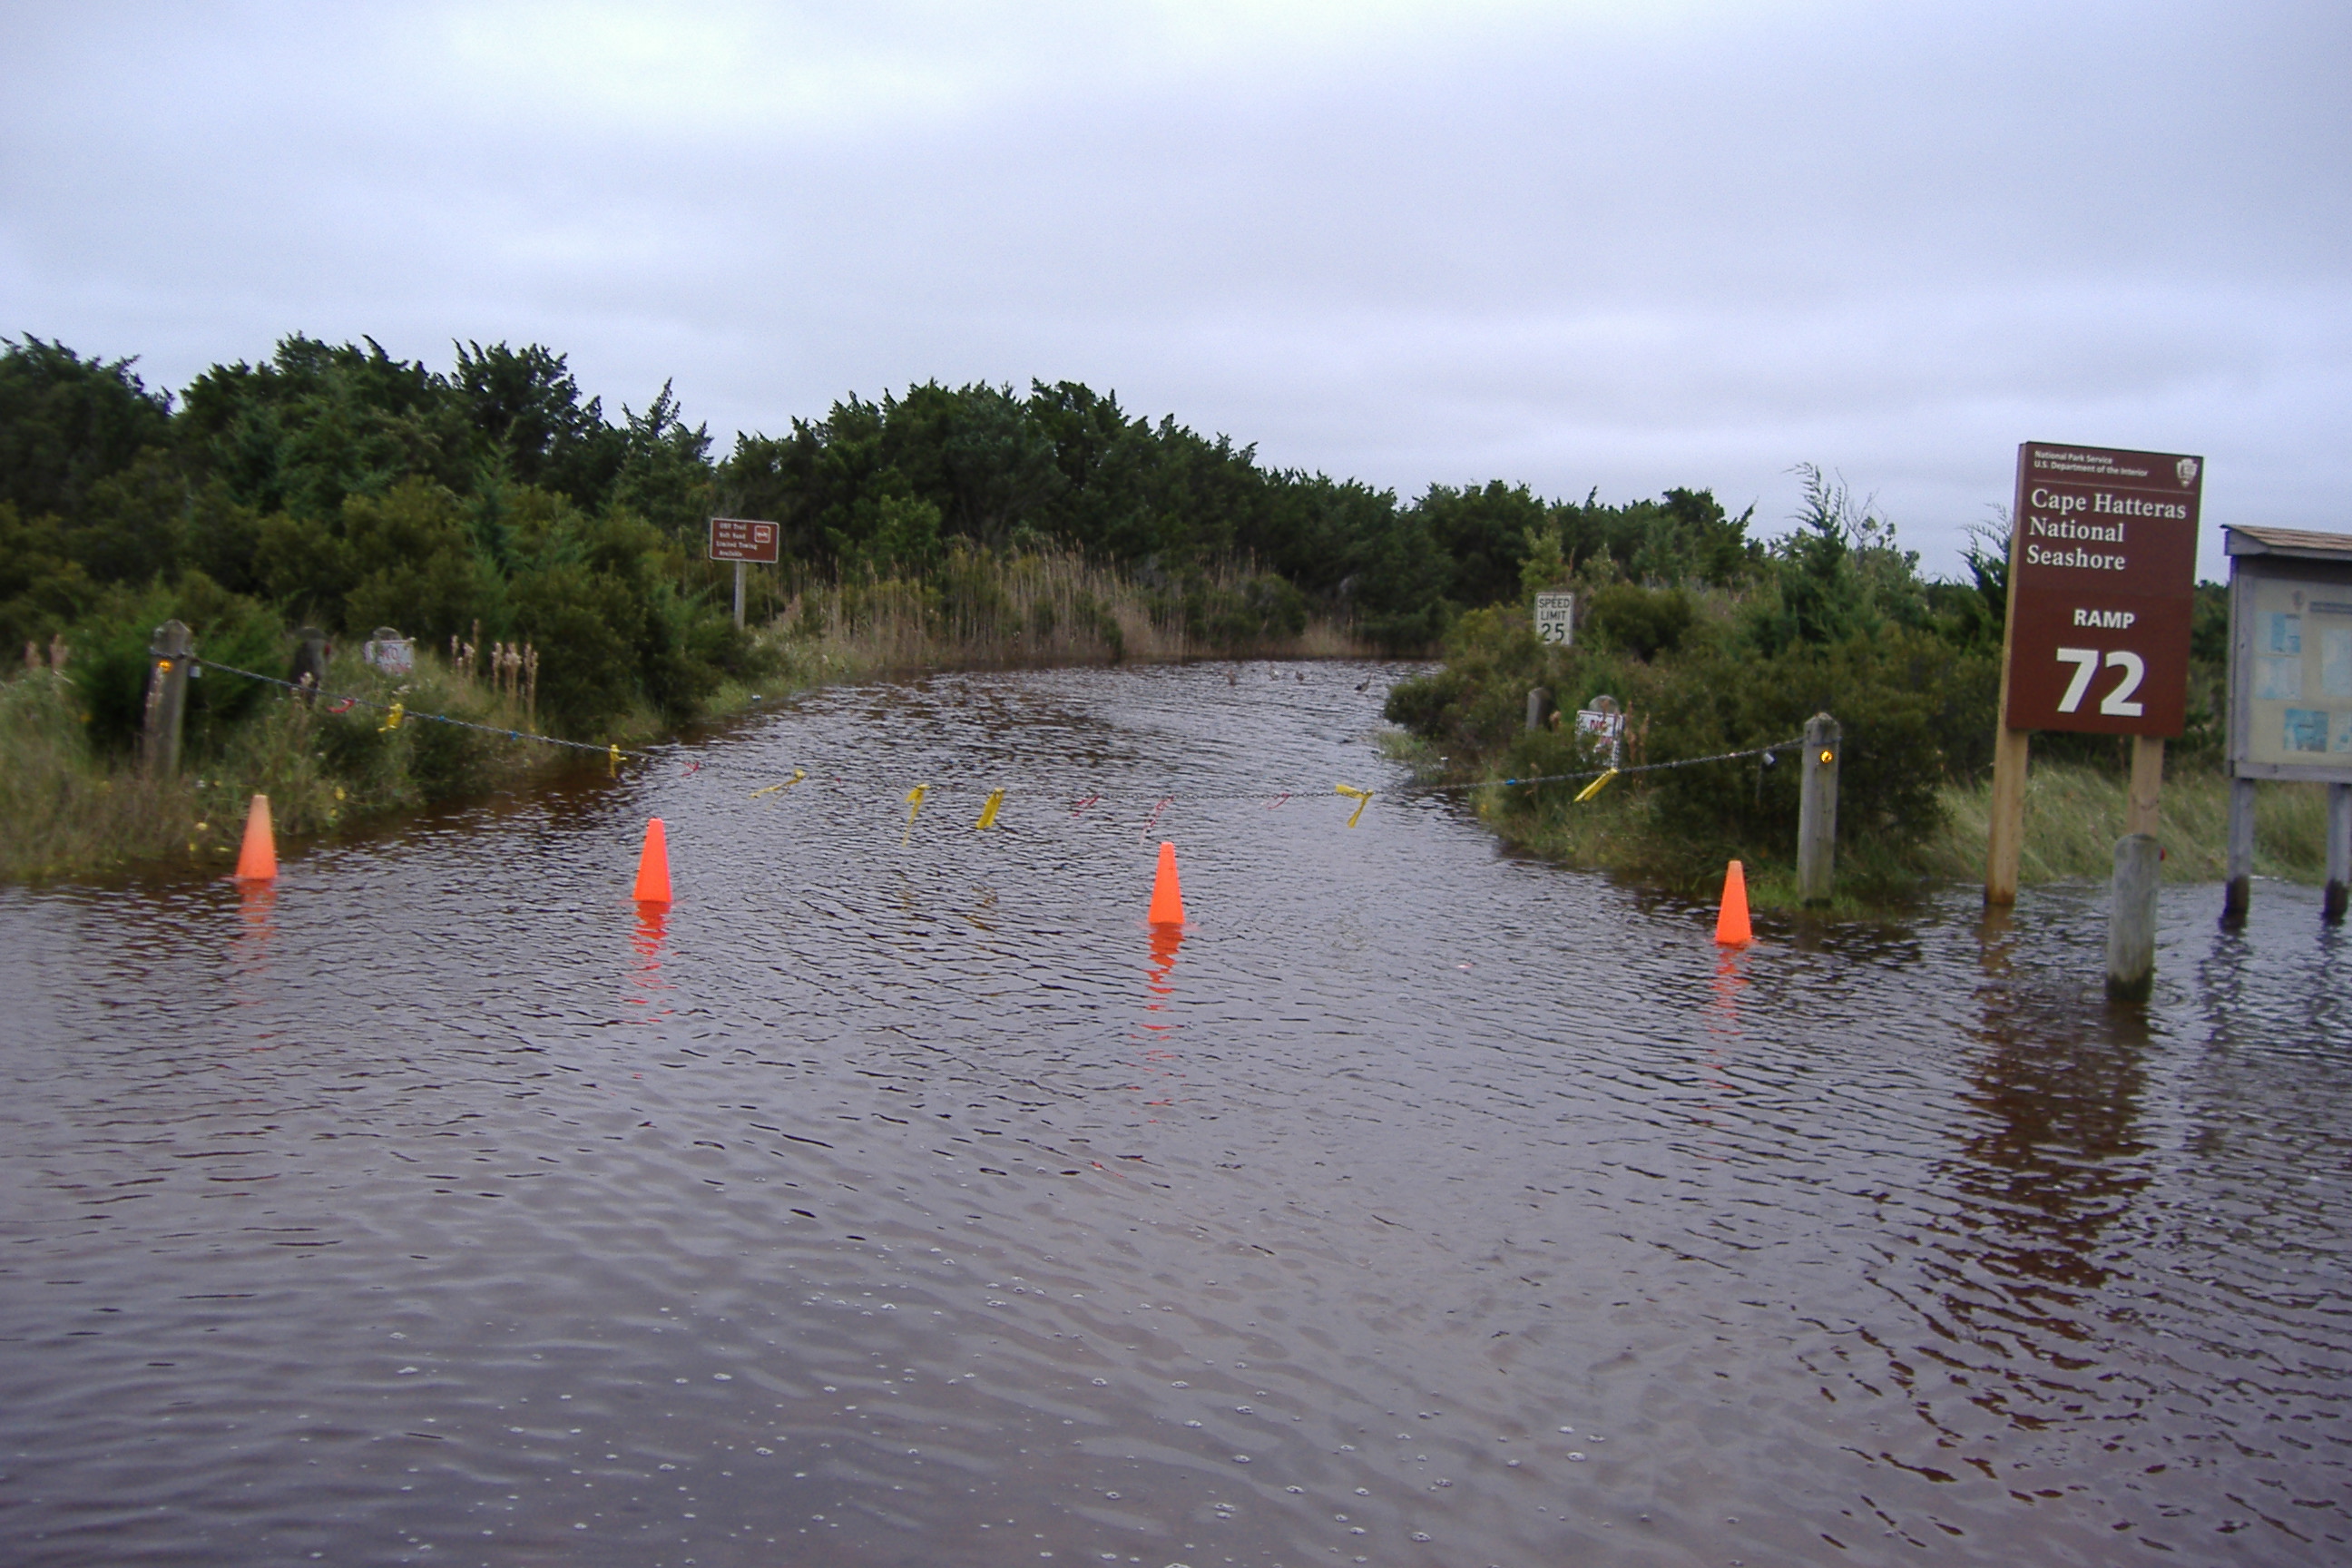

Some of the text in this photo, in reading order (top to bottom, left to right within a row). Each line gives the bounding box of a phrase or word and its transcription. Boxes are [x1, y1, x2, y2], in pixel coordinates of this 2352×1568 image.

[2034, 450, 2112, 465] National Park Service
[2034, 460, 2148, 477] U.S. Department of the Interior
[2031, 487, 2187, 520] Cape Hatteras
[2029, 515, 2124, 543] National
[2026, 544, 2126, 571] Seashore
[1539, 598, 1570, 608] SPEED
[1541, 610, 1566, 621] LIMIT
[2073, 609, 2135, 629] RAMP
[1542, 622, 1564, 642] 25
[2056, 647, 2145, 717] 72
